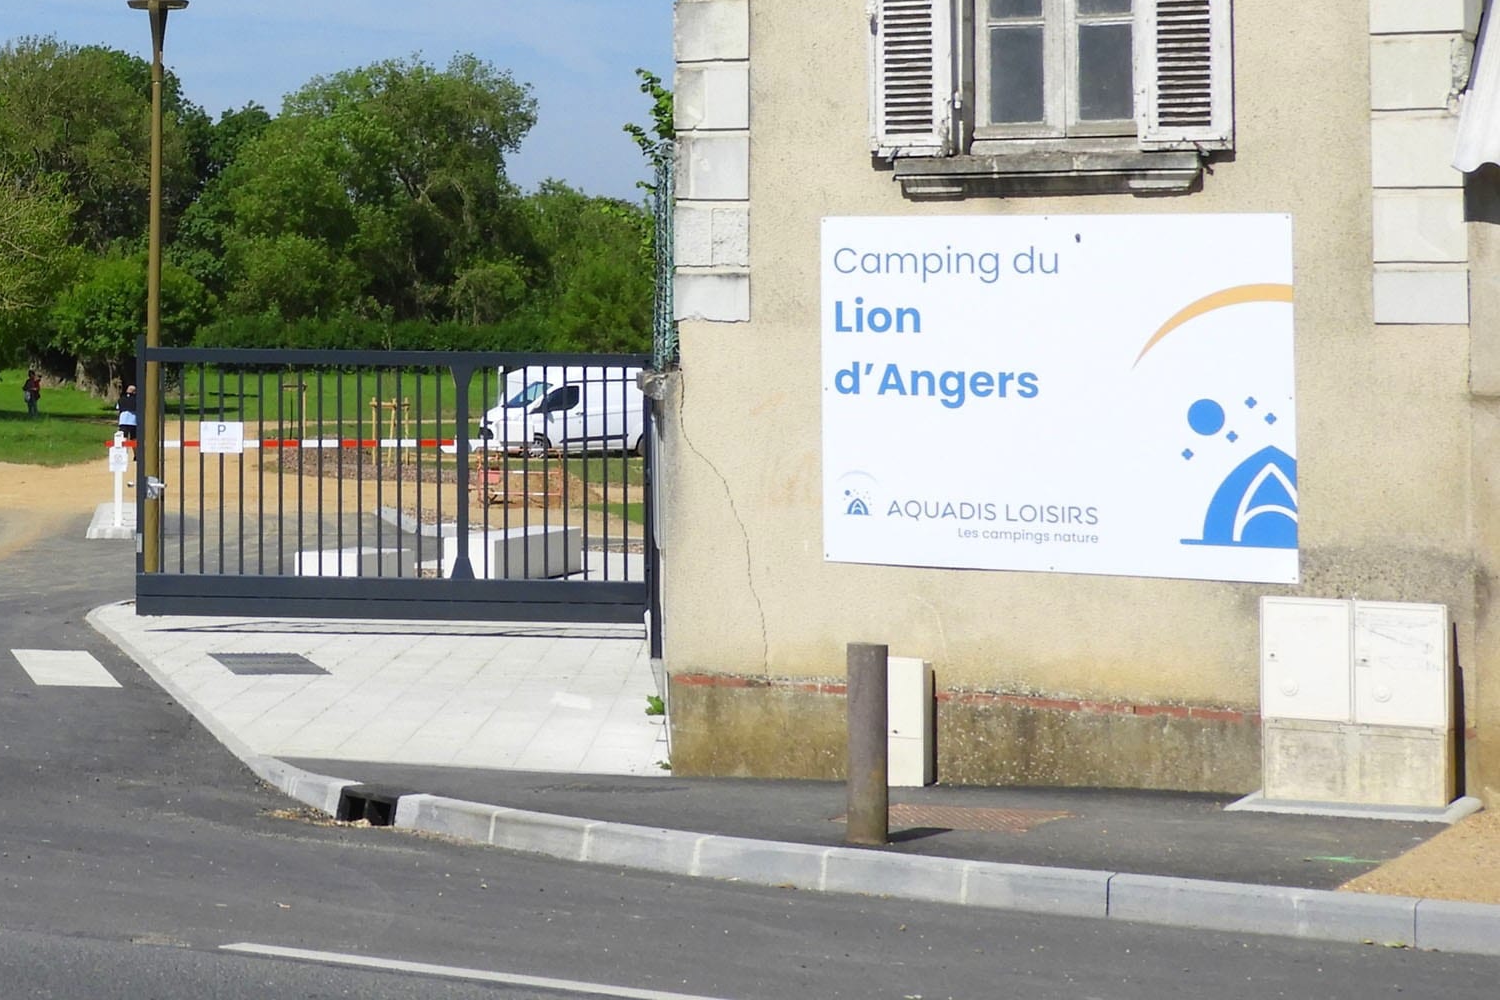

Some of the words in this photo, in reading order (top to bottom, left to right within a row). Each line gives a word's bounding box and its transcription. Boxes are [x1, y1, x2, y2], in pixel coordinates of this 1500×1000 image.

[834, 245, 999, 284] Camping
[1013, 245, 1059, 275] du
[834, 296, 921, 333] Lion
[834, 361, 1040, 409] d’Angers
[217, 424, 227, 436] P
[887, 499, 997, 521] AQUADIS
[1005, 503, 1099, 526] LOISIRS
[957, 527, 979, 539] Les
[982, 529, 1050, 545] campings
[1053, 532, 1099, 544] nature
